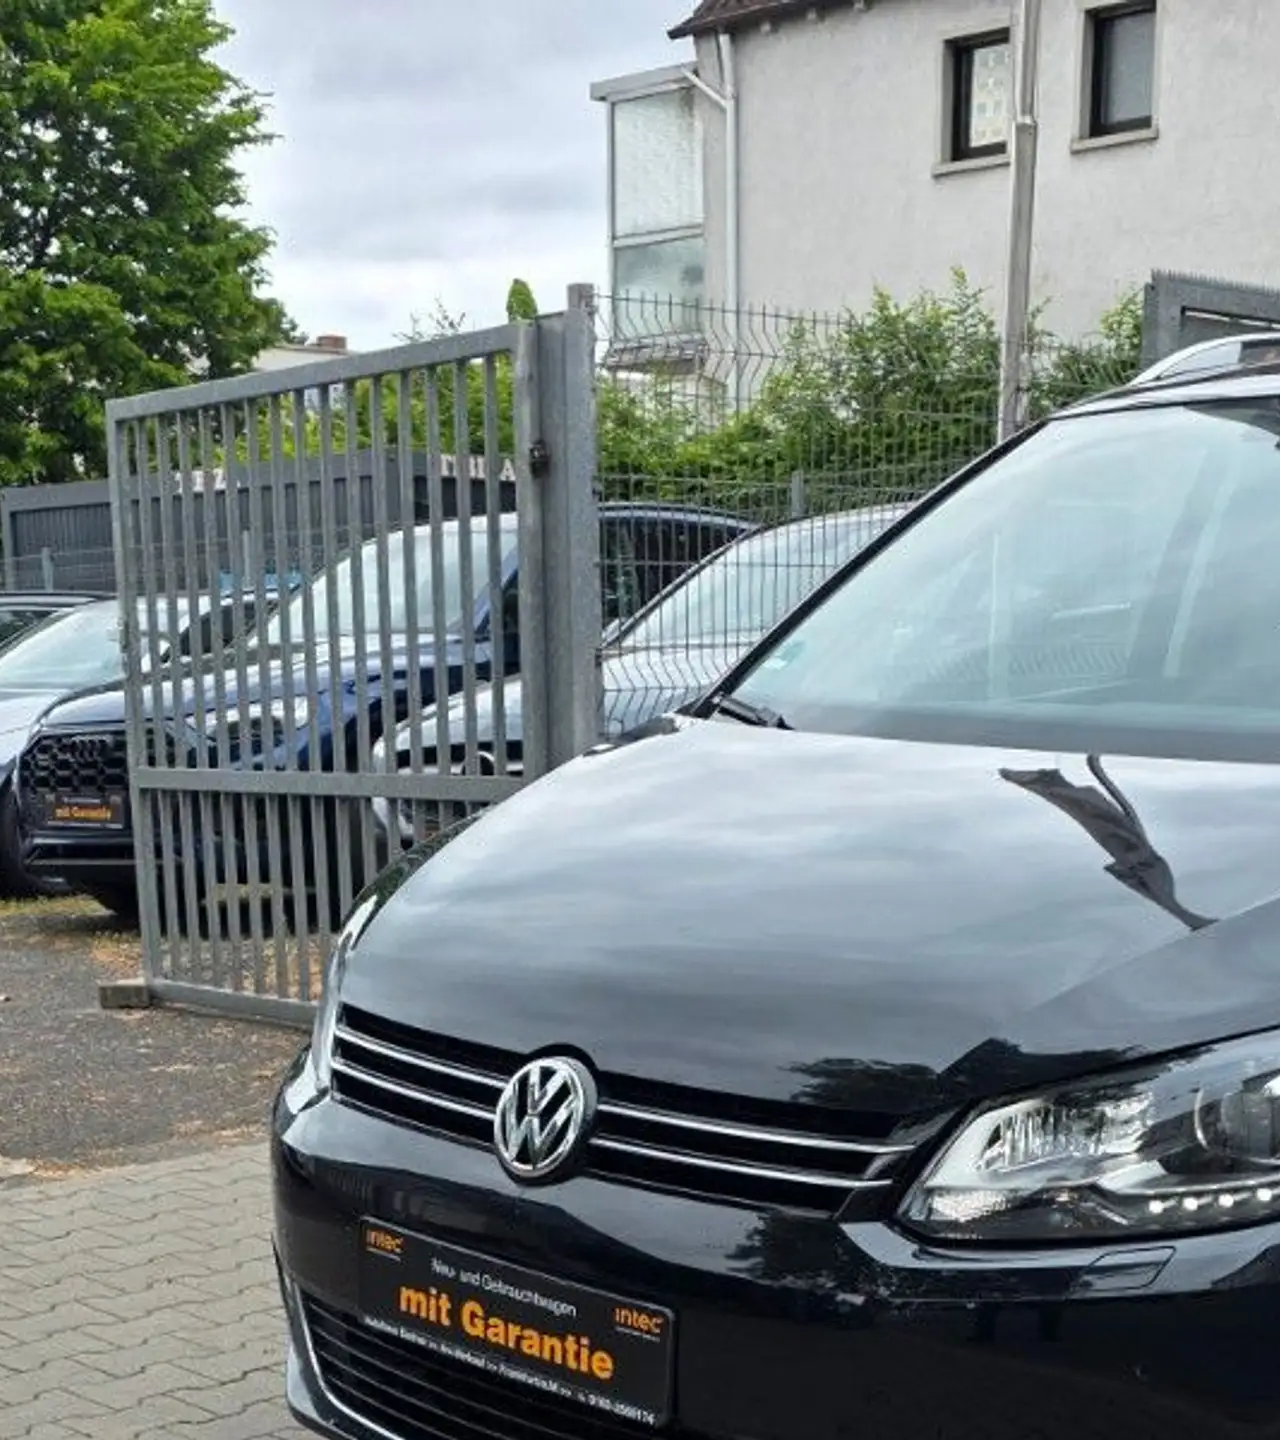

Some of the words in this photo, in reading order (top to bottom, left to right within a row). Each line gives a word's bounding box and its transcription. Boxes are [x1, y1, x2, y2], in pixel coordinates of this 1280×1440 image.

[399, 1285, 452, 1326] mit
[461, 1299, 614, 1380] Garantie
[615, 1307, 664, 1334] intec
